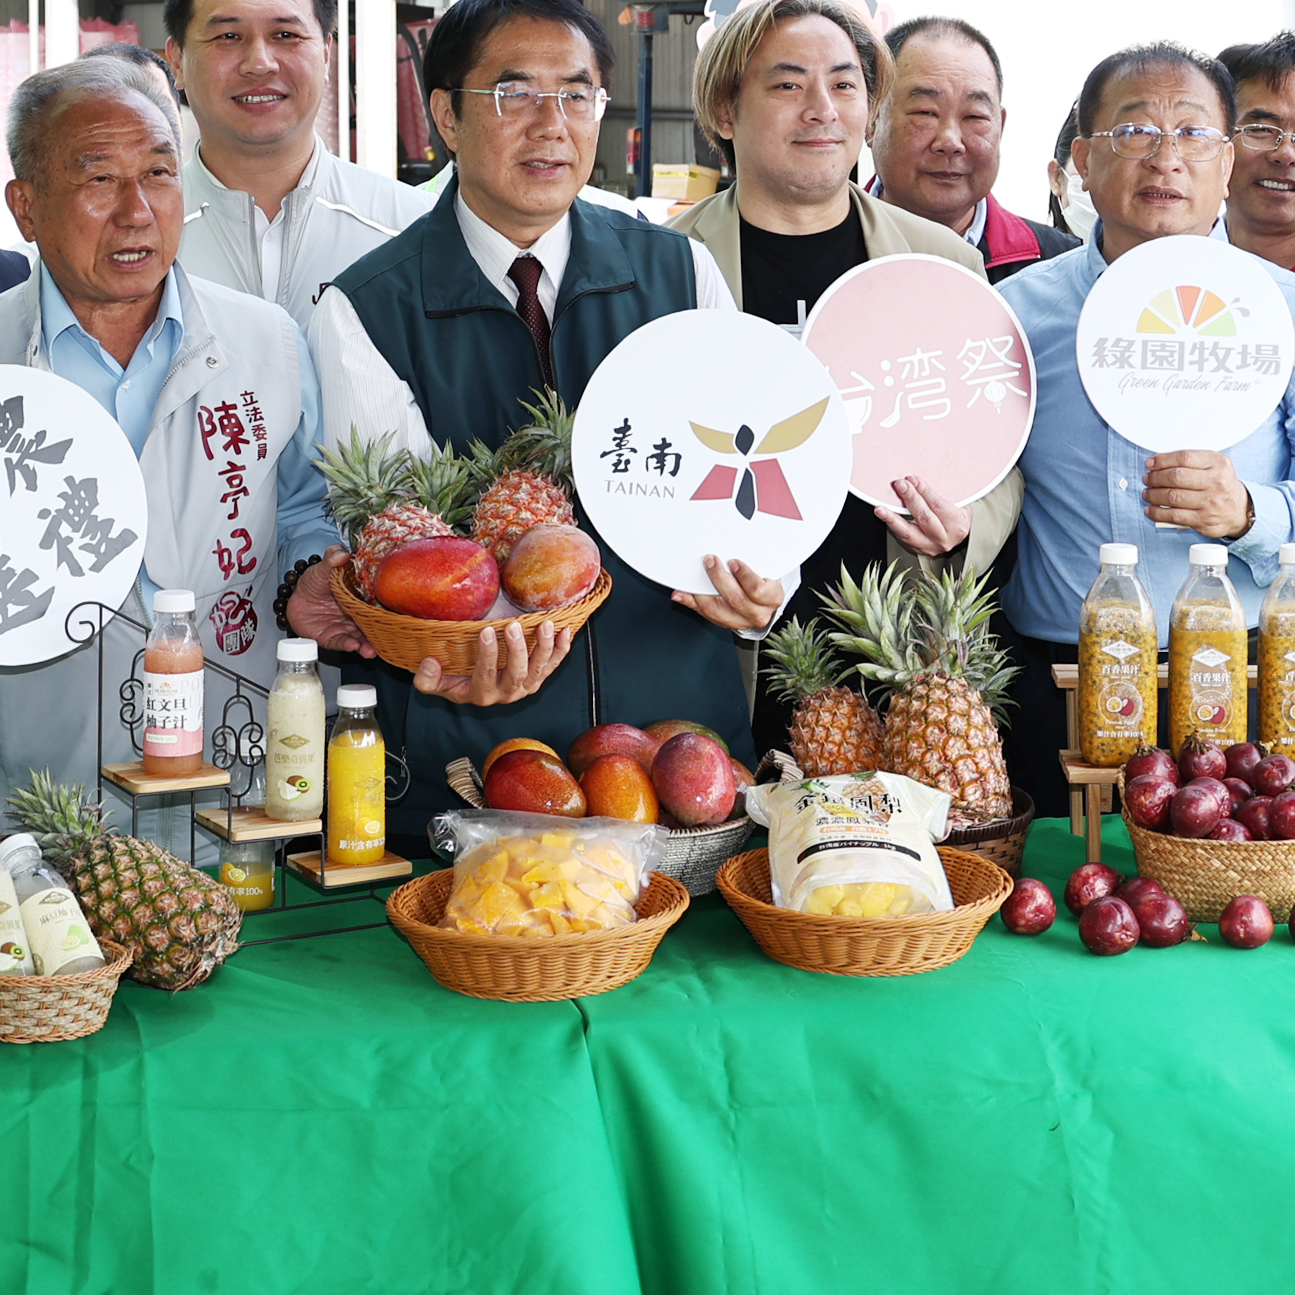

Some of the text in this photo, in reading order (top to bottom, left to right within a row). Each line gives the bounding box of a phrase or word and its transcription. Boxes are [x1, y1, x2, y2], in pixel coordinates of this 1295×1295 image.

[1091, 337, 1282, 376] 綠園牧場
[1118, 371, 1252, 397] Green Garden Farm
[240, 390, 269, 461] 立法委員
[600, 417, 682, 478] 臺南
[198, 400, 257, 581] 陳亭妃
[604, 479, 676, 500] TAINAN
[1102, 664, 1142, 675] 百香果汁
[1193, 672, 1230, 683] 百香果汁
[147, 697, 187, 712] 紅文旦
[147, 714, 187, 729] 柚子汁
